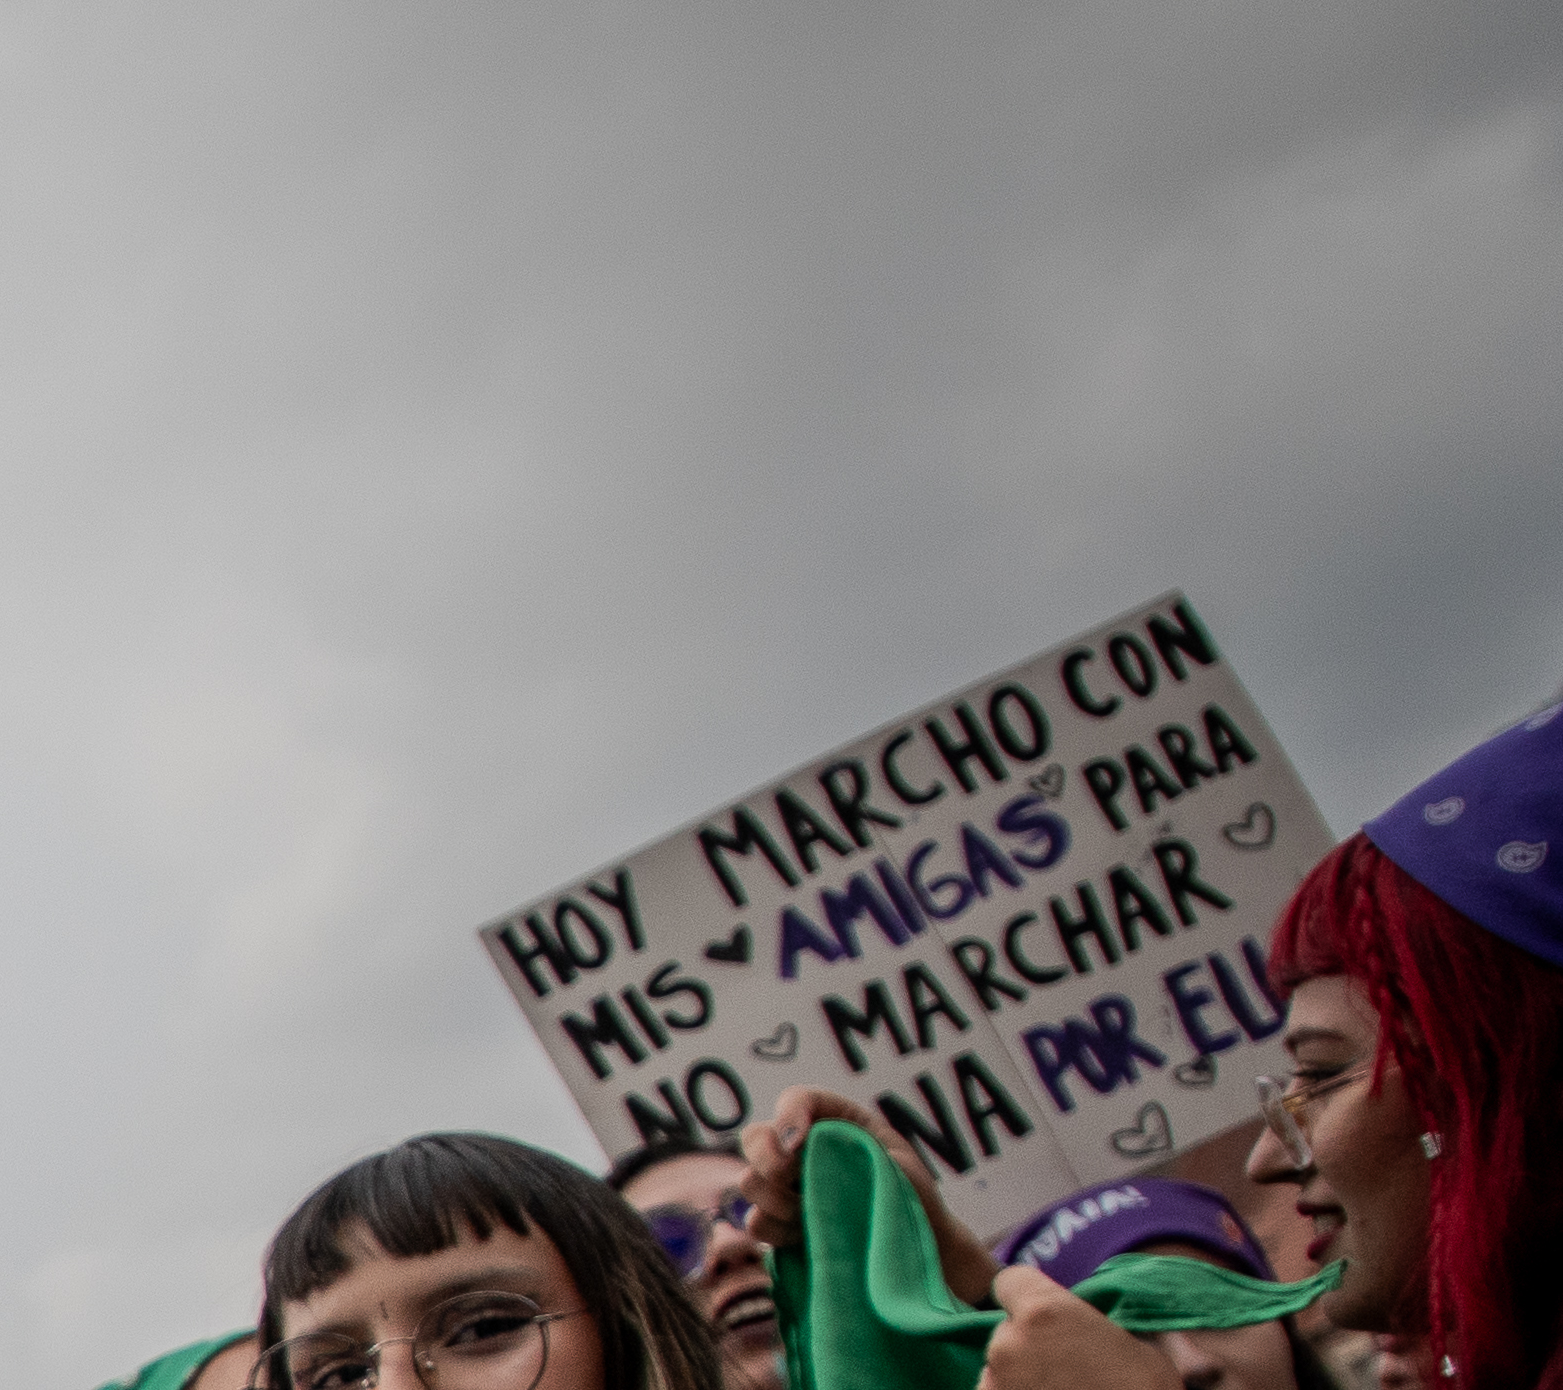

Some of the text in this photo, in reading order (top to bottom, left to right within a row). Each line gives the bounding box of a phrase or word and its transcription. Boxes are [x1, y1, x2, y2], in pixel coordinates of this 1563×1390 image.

[497, 599, 1217, 998] HOY MARCHO CON
[559, 703, 1259, 1080] MIS AMIGAS PARA
[624, 833, 1235, 1146] NO MARCHAR
[1021, 993, 1168, 1112] POR
